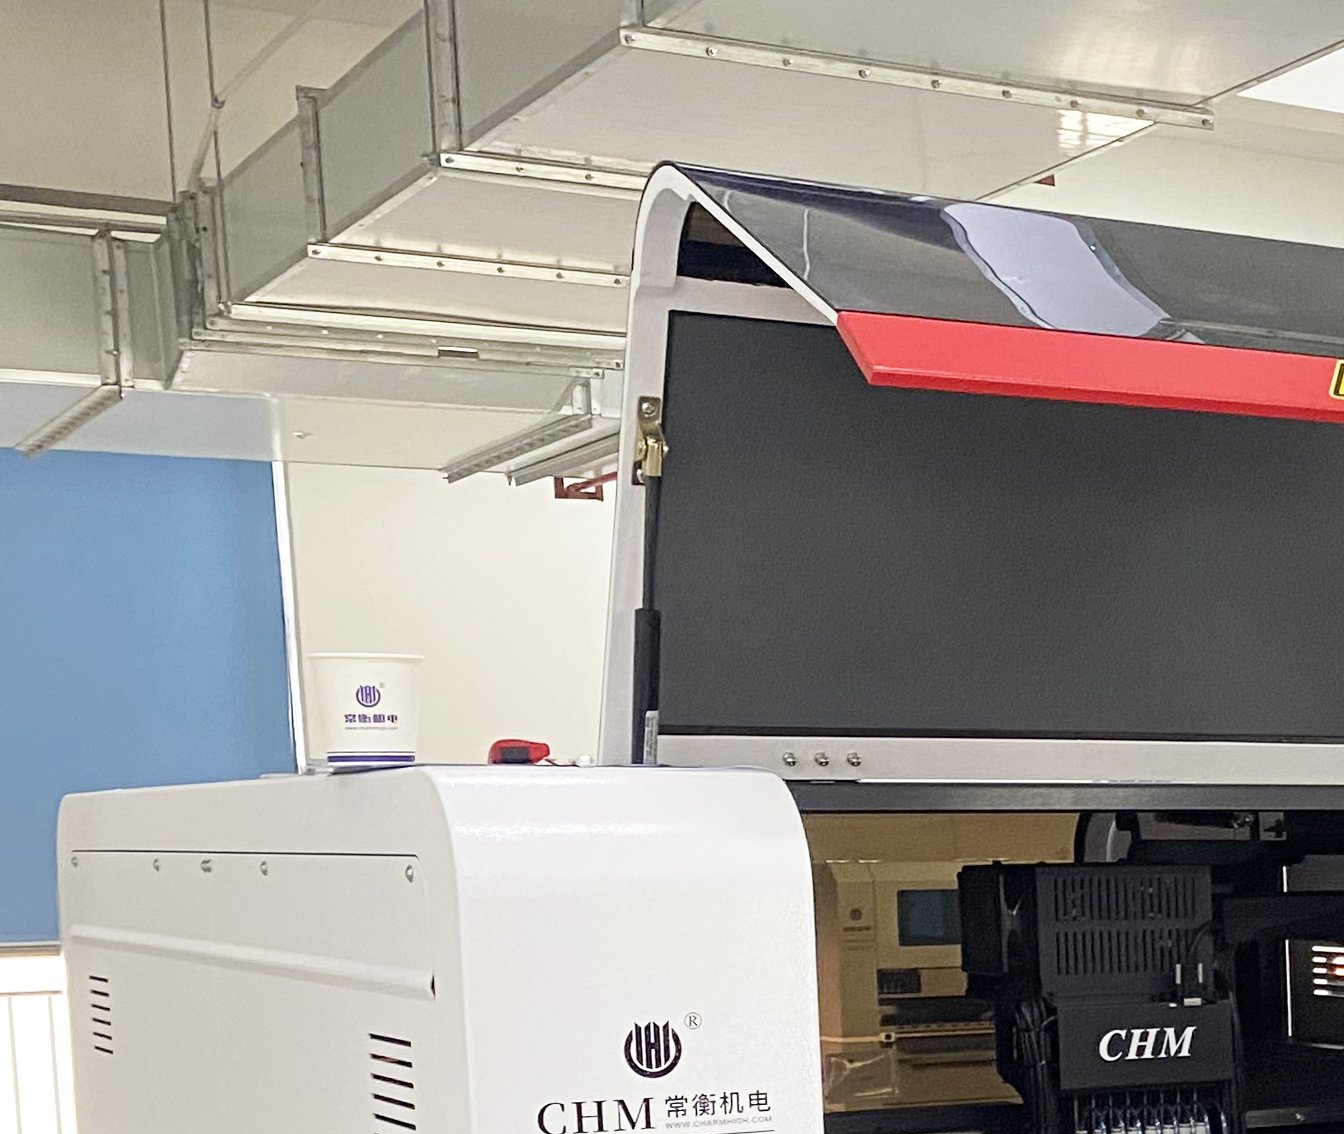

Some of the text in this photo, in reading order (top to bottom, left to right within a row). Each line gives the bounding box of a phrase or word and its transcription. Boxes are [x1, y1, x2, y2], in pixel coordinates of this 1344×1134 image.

[1098, 1026, 1198, 1062] CHM
[665, 1089, 771, 1118] 常衡机电
[665, 1115, 773, 1129] WWW.CHARMHIGH.COM
